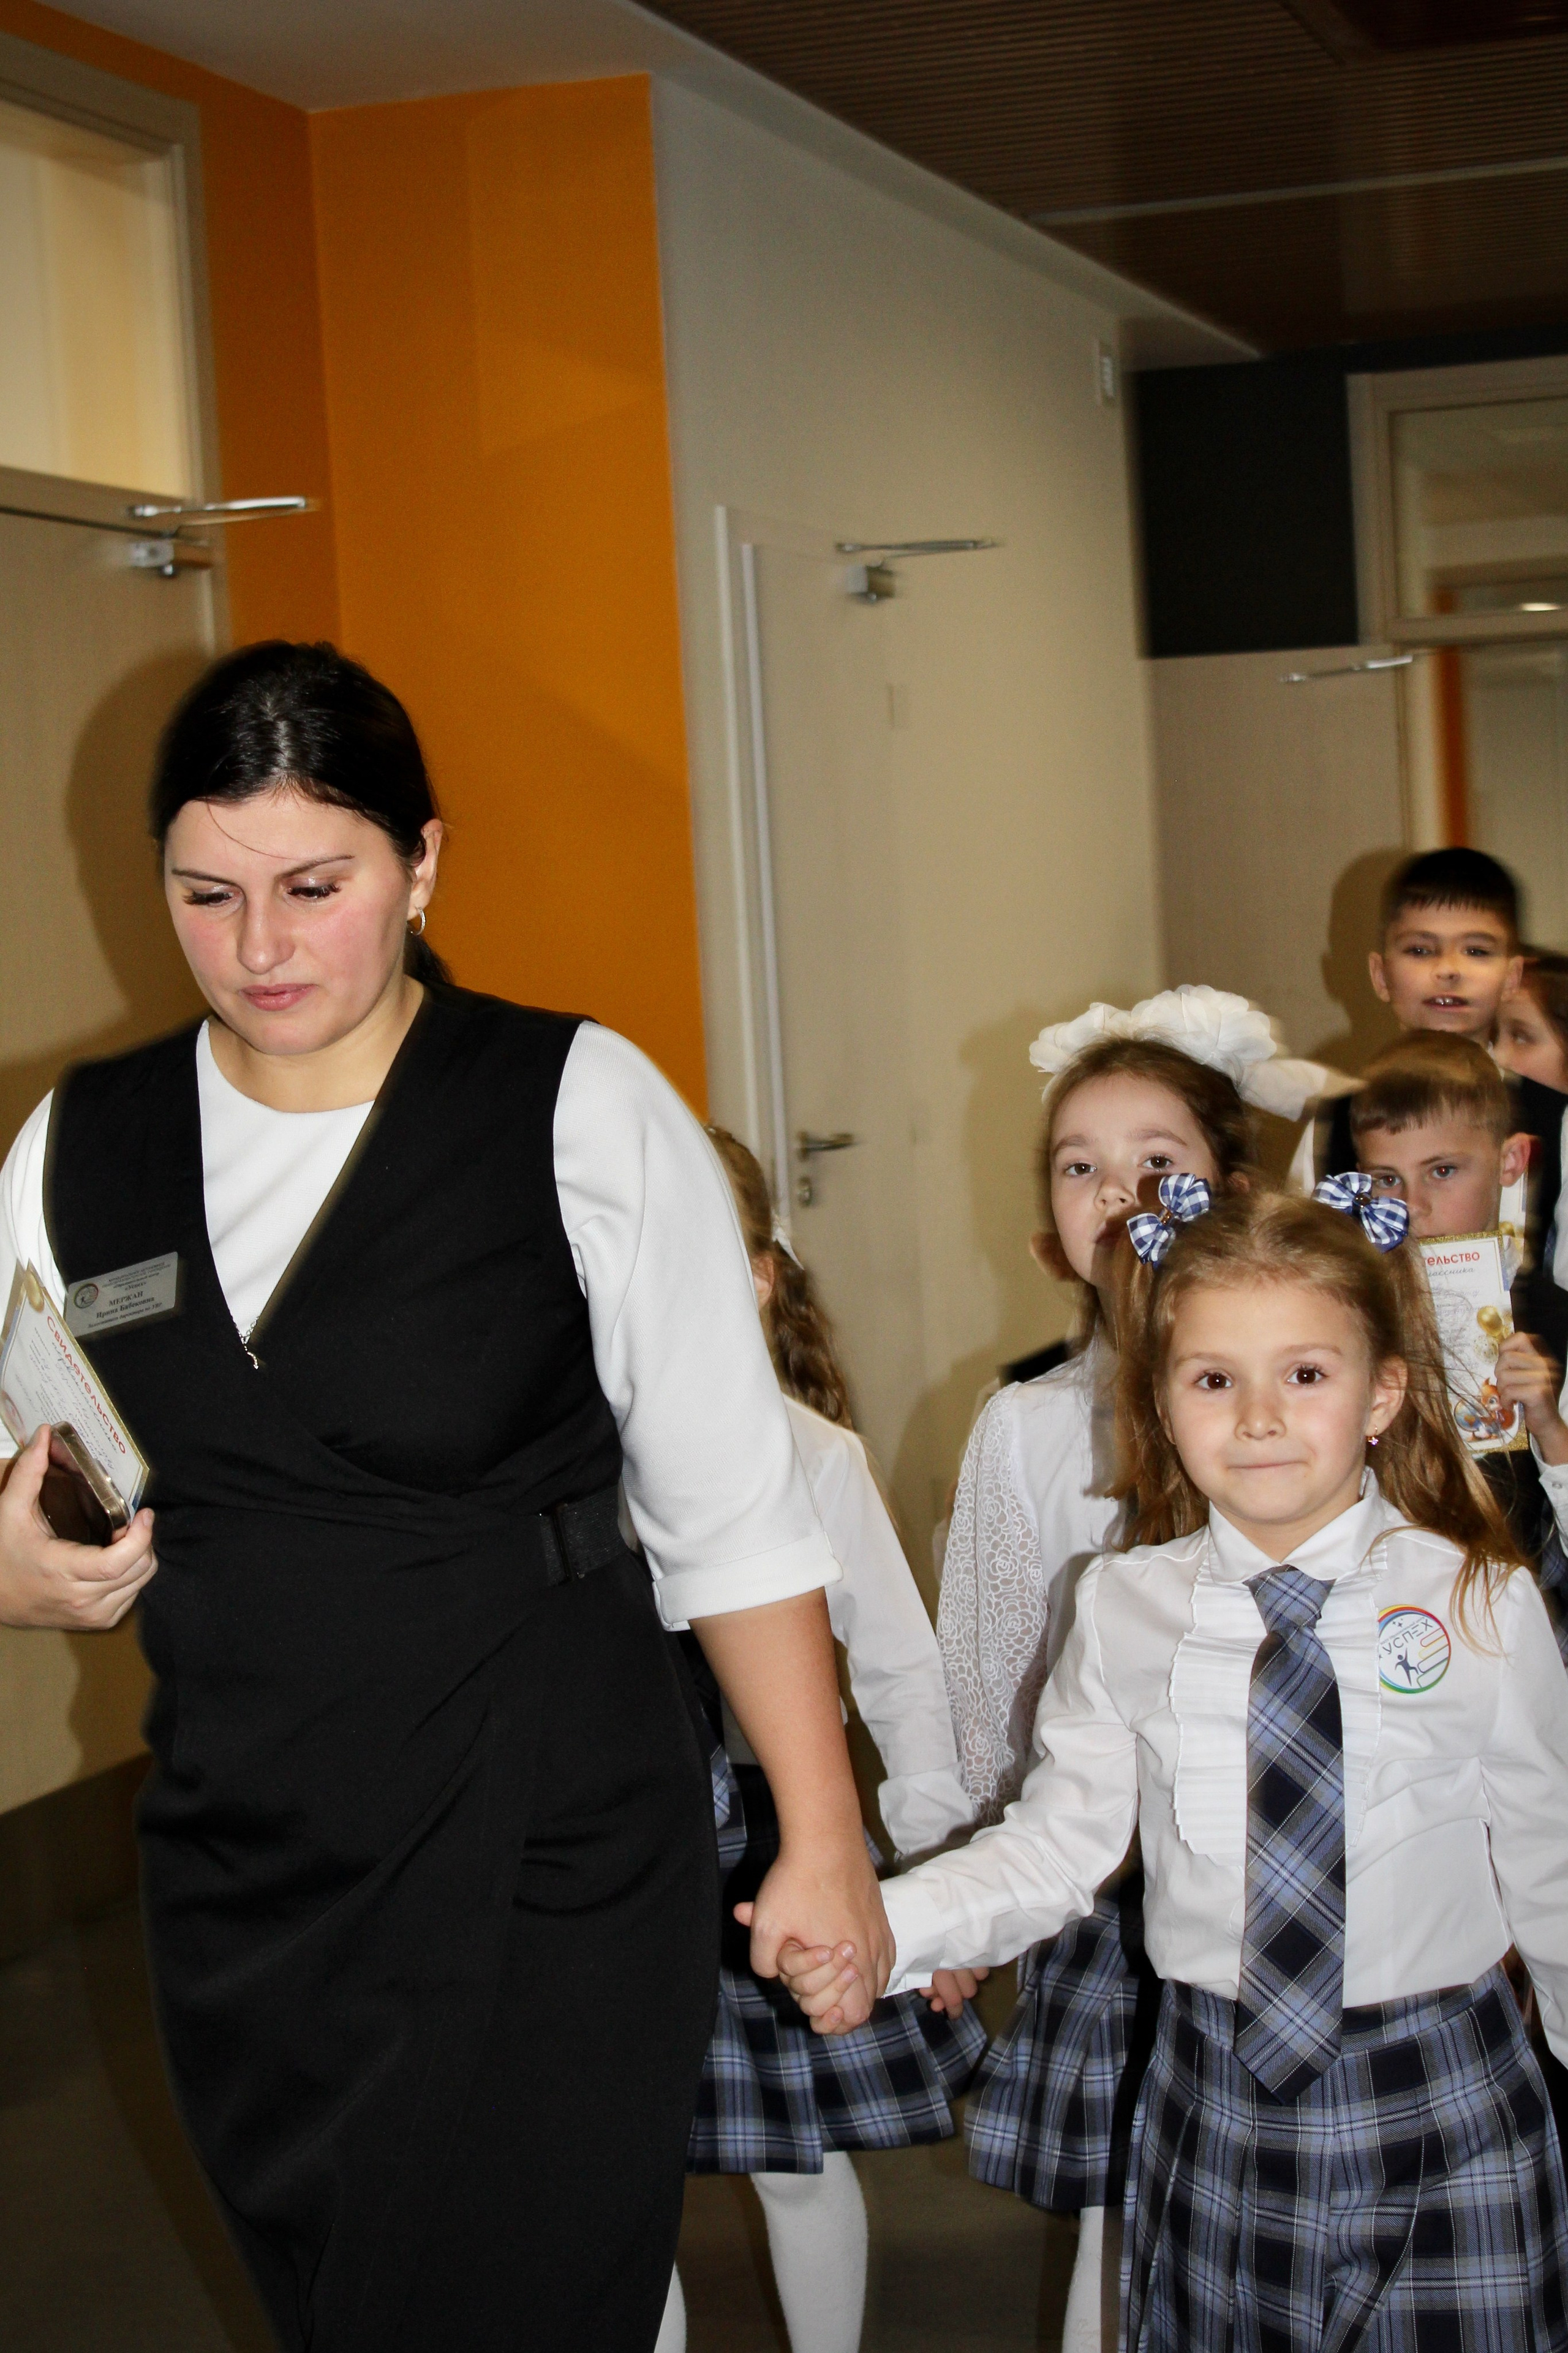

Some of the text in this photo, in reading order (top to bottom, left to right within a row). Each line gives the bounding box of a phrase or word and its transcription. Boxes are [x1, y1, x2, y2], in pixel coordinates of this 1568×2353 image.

[1426, 1252, 1480, 1266] ельство
[109, 1291, 144, 1306] МЕРЖАН
[97, 1307, 118, 1318] Ирина
[47, 1315, 126, 1454] Свидетельство
[1382, 1618, 1433, 1655] УСПЕХ
